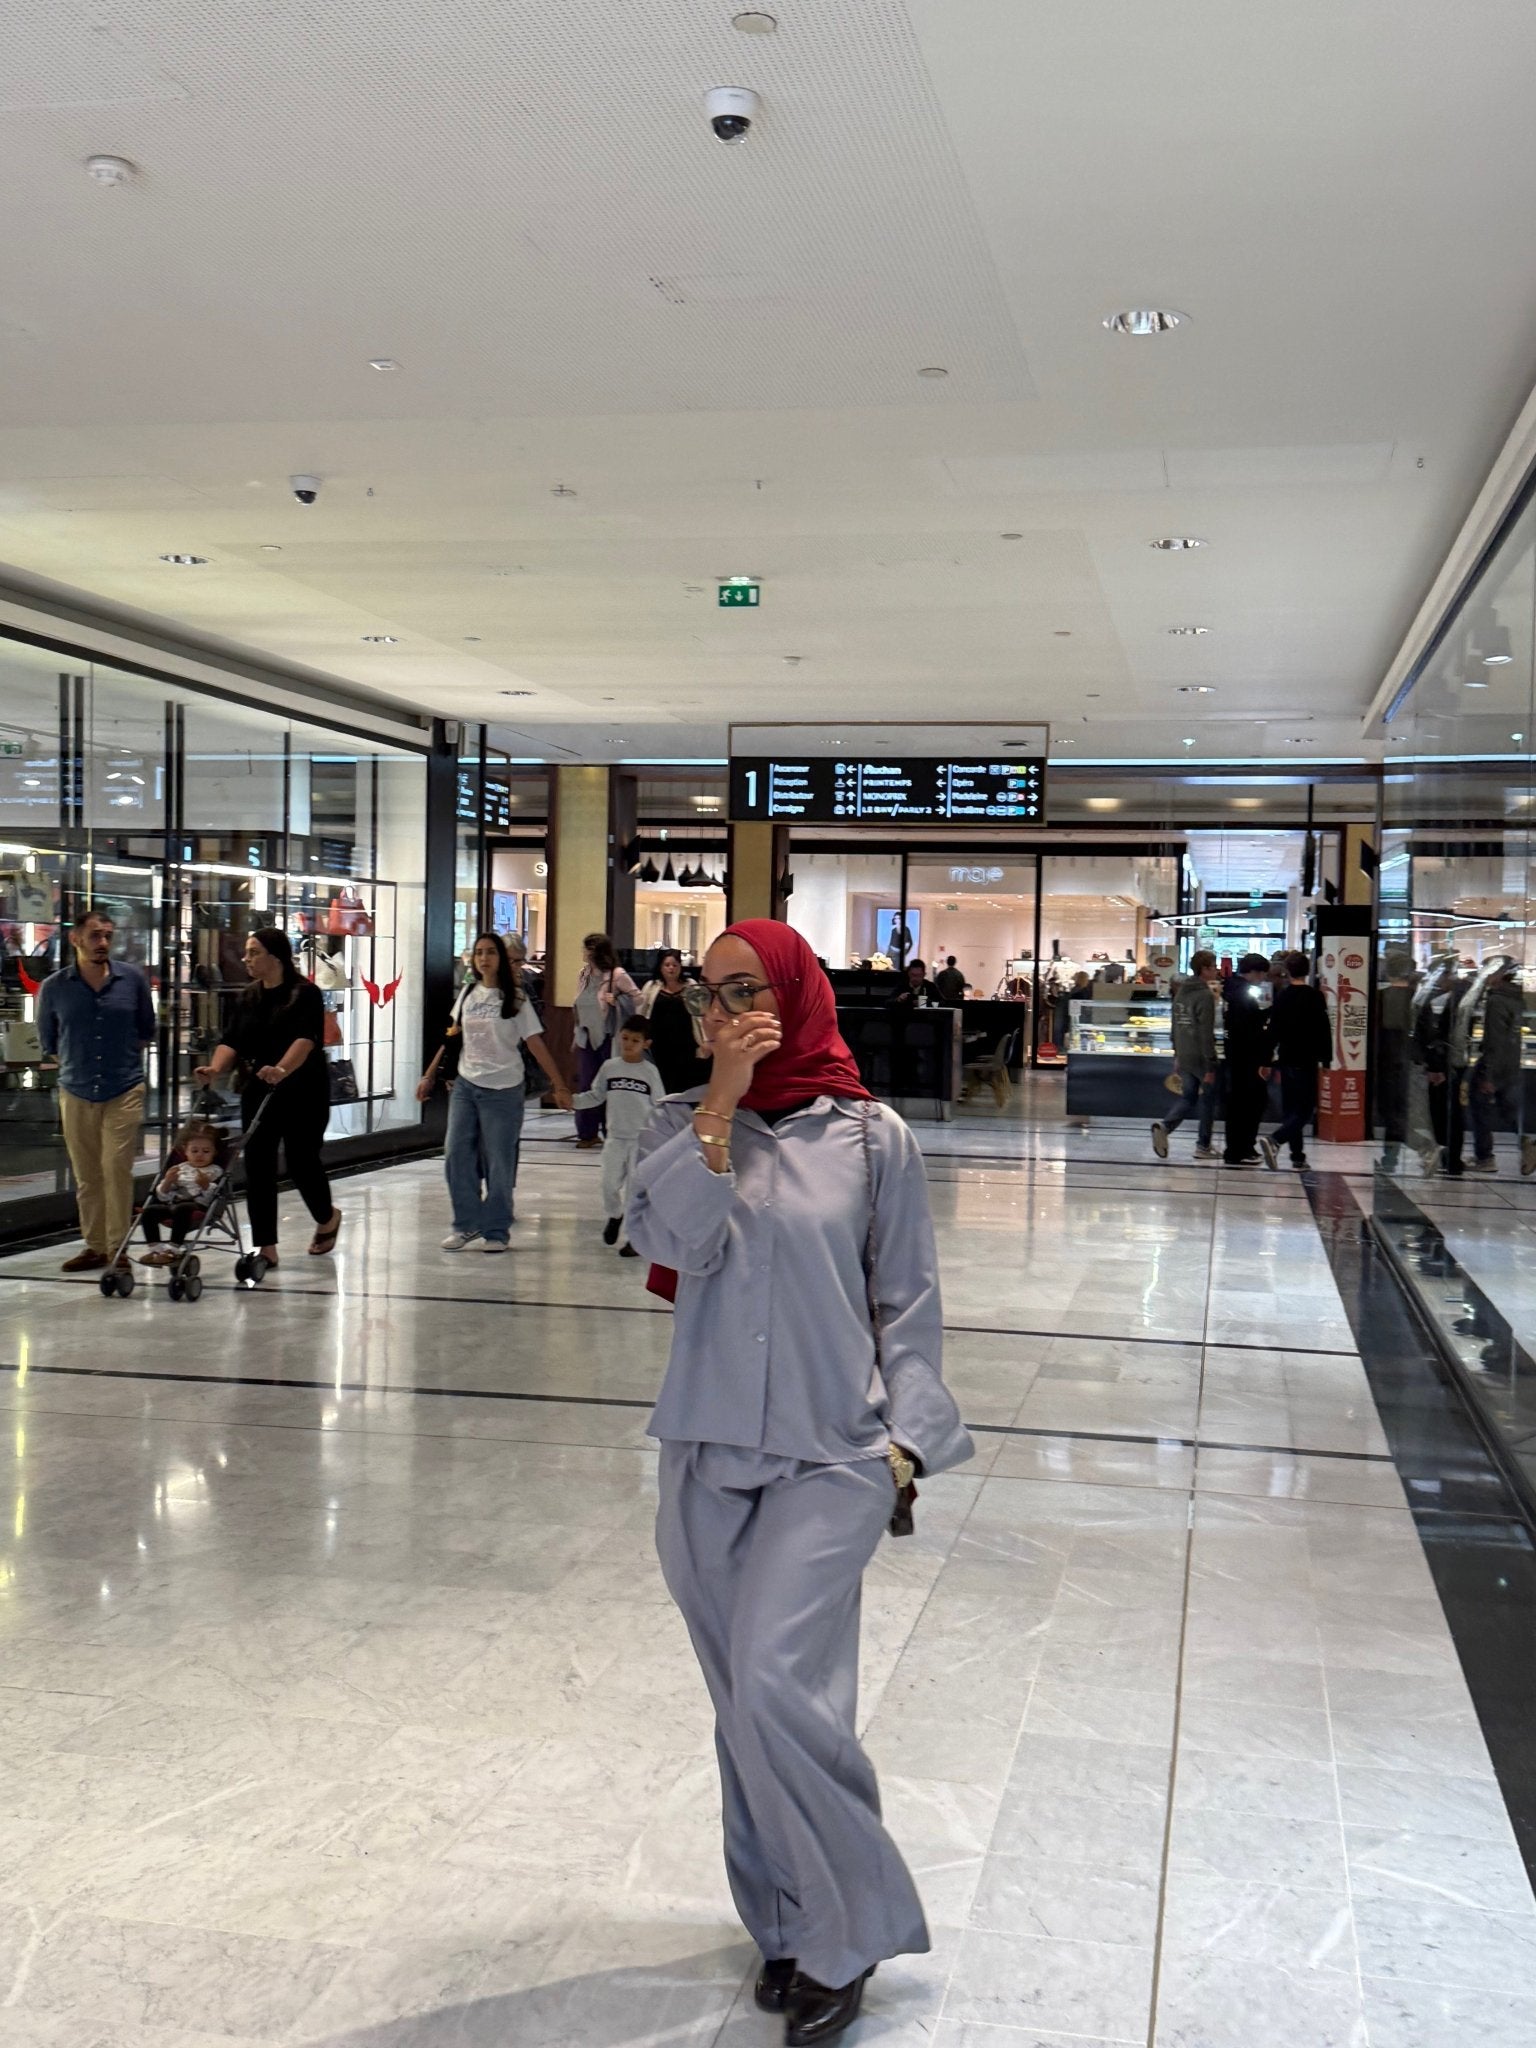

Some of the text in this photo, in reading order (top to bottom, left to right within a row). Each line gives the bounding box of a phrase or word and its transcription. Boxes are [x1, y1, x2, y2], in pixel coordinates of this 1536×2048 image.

[745, 770, 757, 807] 1
[949, 866, 1004, 886] maje
[610, 1078, 648, 1093] adidas
